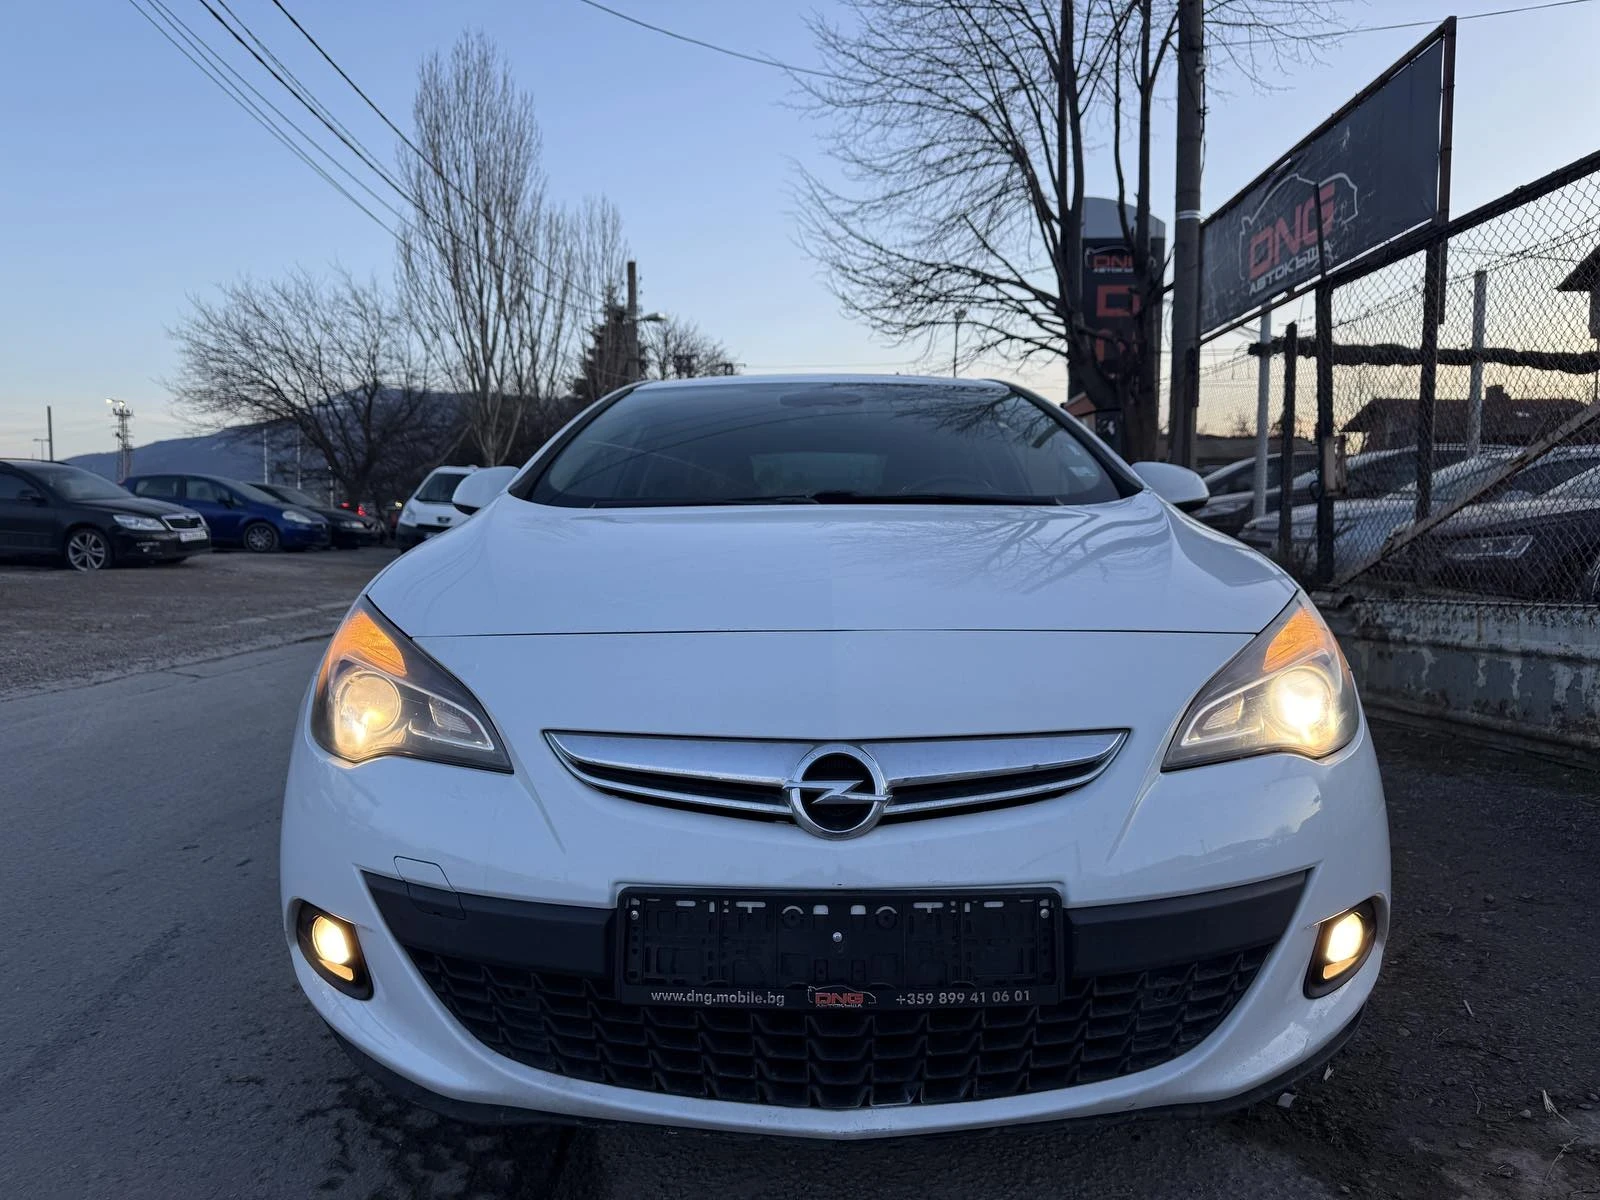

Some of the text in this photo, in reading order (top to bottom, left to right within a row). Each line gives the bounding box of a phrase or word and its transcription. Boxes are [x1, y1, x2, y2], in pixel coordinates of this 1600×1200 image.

[1248, 183, 1336, 279] DNG
[1093, 255, 1133, 268] DN
[651, 989, 785, 1007] www.dng.mobile.bg
[815, 992, 864, 1004] DNG
[895, 990, 1030, 1005] +359 899 41 06 01
